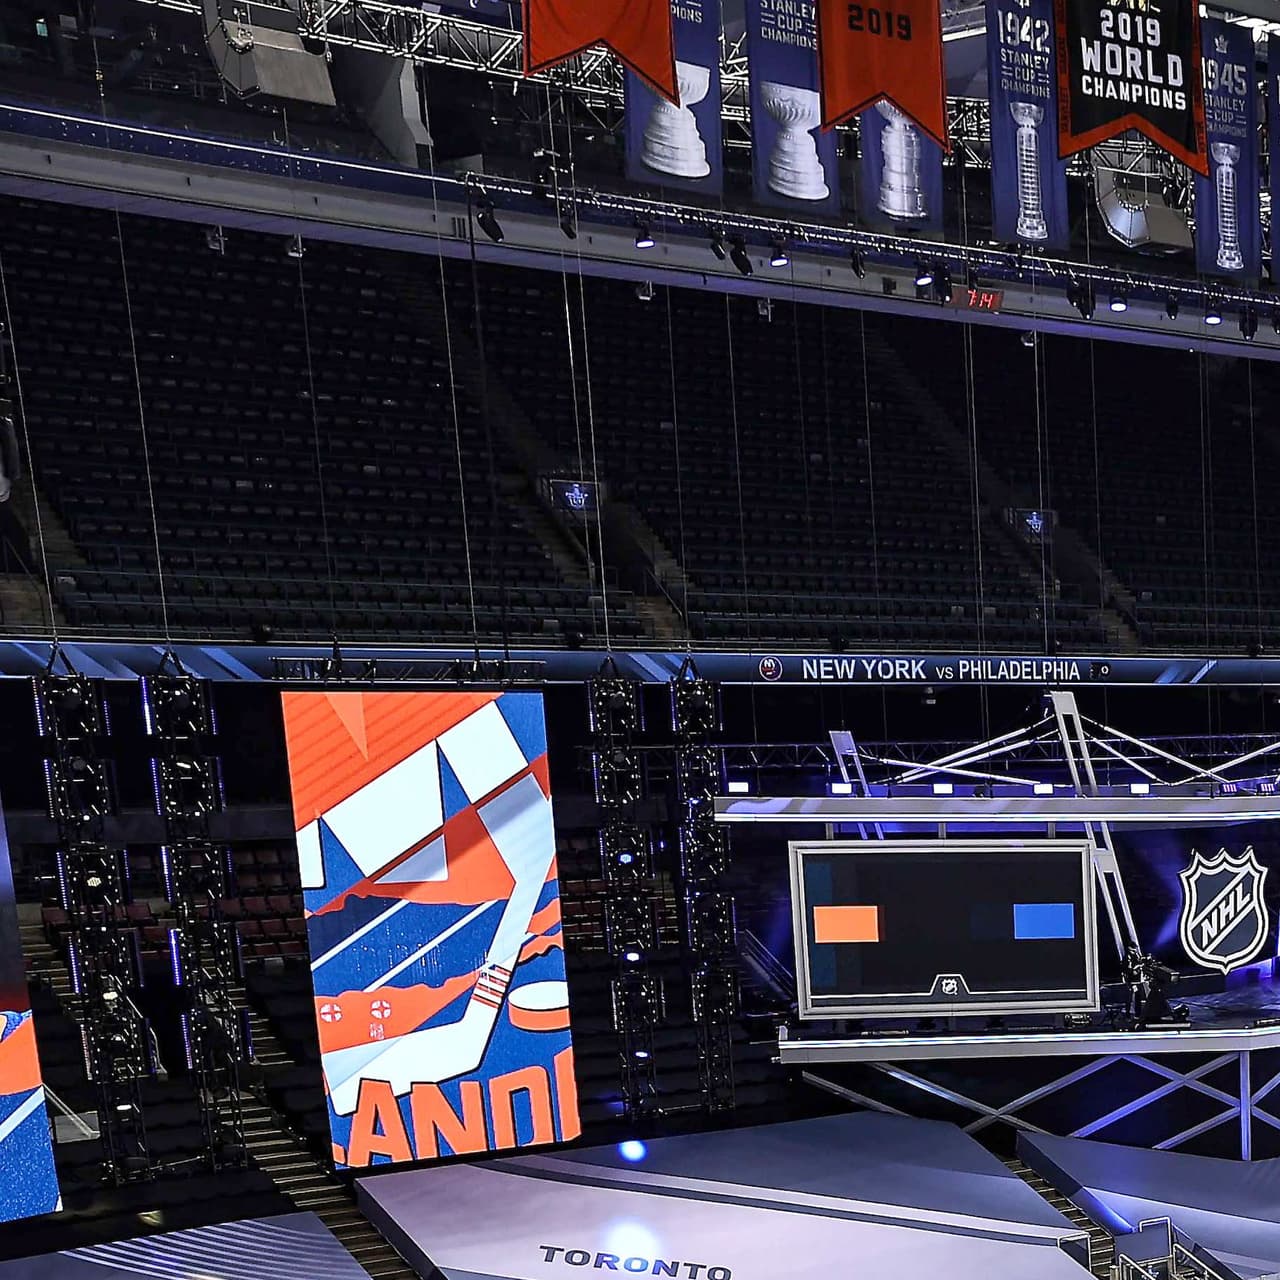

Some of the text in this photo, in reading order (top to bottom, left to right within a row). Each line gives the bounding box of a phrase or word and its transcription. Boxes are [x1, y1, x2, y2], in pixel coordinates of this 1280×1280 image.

[760, 0, 817, 20] STANLEY
[778, 15, 803, 33] CUP
[848, 4, 912, 41] 2019
[997, 10, 1050, 54] 1942
[1100, 8, 1161, 47] 2019
[761, 27, 817, 50] CHAMPIONS
[1001, 48, 1049, 71] STANLEY
[1081, 37, 1184, 87] WORLD
[1015, 66, 1036, 82] CUP
[1202, 57, 1247, 96] 1945
[1001, 78, 1050, 100] CHAMPIONS
[1082, 75, 1187, 111] CHAMPIONS
[1204, 92, 1245, 113] STANLEY
[1215, 110, 1234, 123] CUP
[802, 659, 1081, 681] NEW YORK PHILADELPHIA
[1200, 886, 1252, 943] NHL
